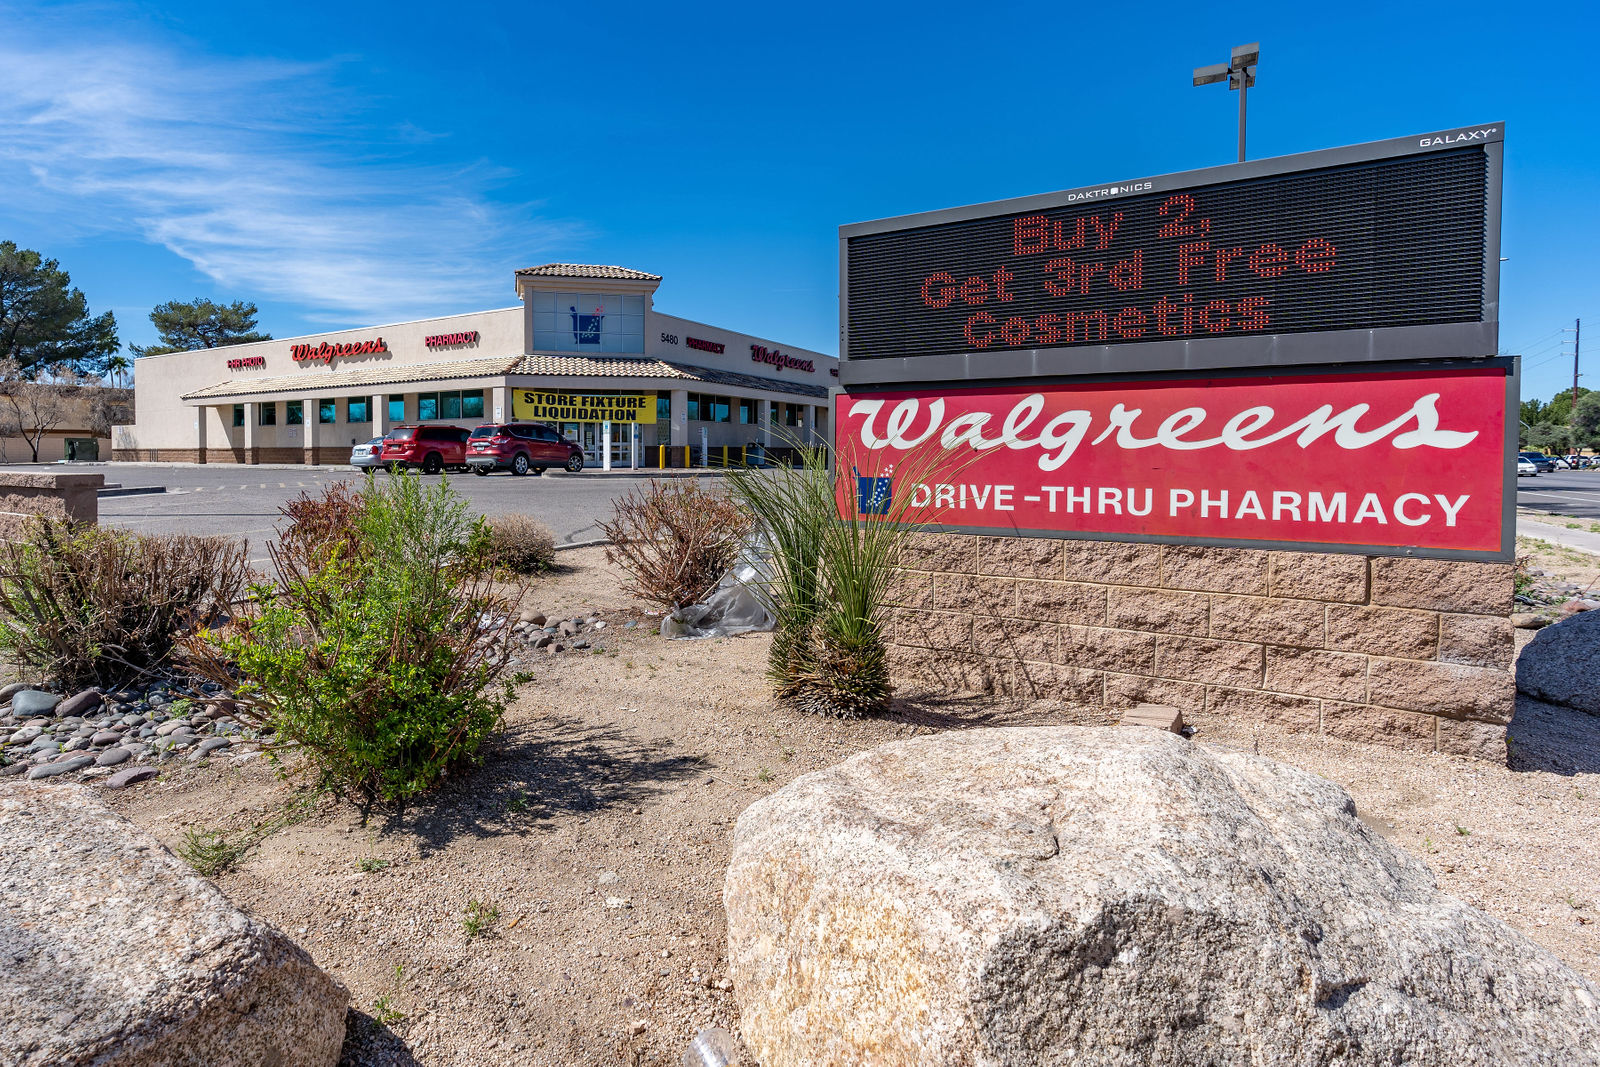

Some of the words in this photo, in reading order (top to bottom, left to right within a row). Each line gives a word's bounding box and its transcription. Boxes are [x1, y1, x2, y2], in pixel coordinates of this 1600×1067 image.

[1013, 211, 1123, 255] Buy
[1158, 193, 1211, 239] 2,
[921, 265, 1013, 309] Get
[1044, 249, 1143, 297] 3rd
[1178, 238, 1337, 285] Free
[964, 293, 1270, 348] Cosmetics
[290, 337, 386, 364] Walgreens
[425, 330, 477, 347] PHARMACY
[661, 332, 679, 345] 5480
[686, 337, 726, 354] PHARMACY
[241, 356, 263, 367] PHOTO
[751, 344, 816, 373] Walgreens
[524, 392, 577, 406] STORE
[581, 396, 646, 408] FIXTURE
[534, 405, 637, 421] LIQUIDATION
[848, 393, 1479, 472] Walgreens
[1169, 489, 1471, 527] PHARMACY
